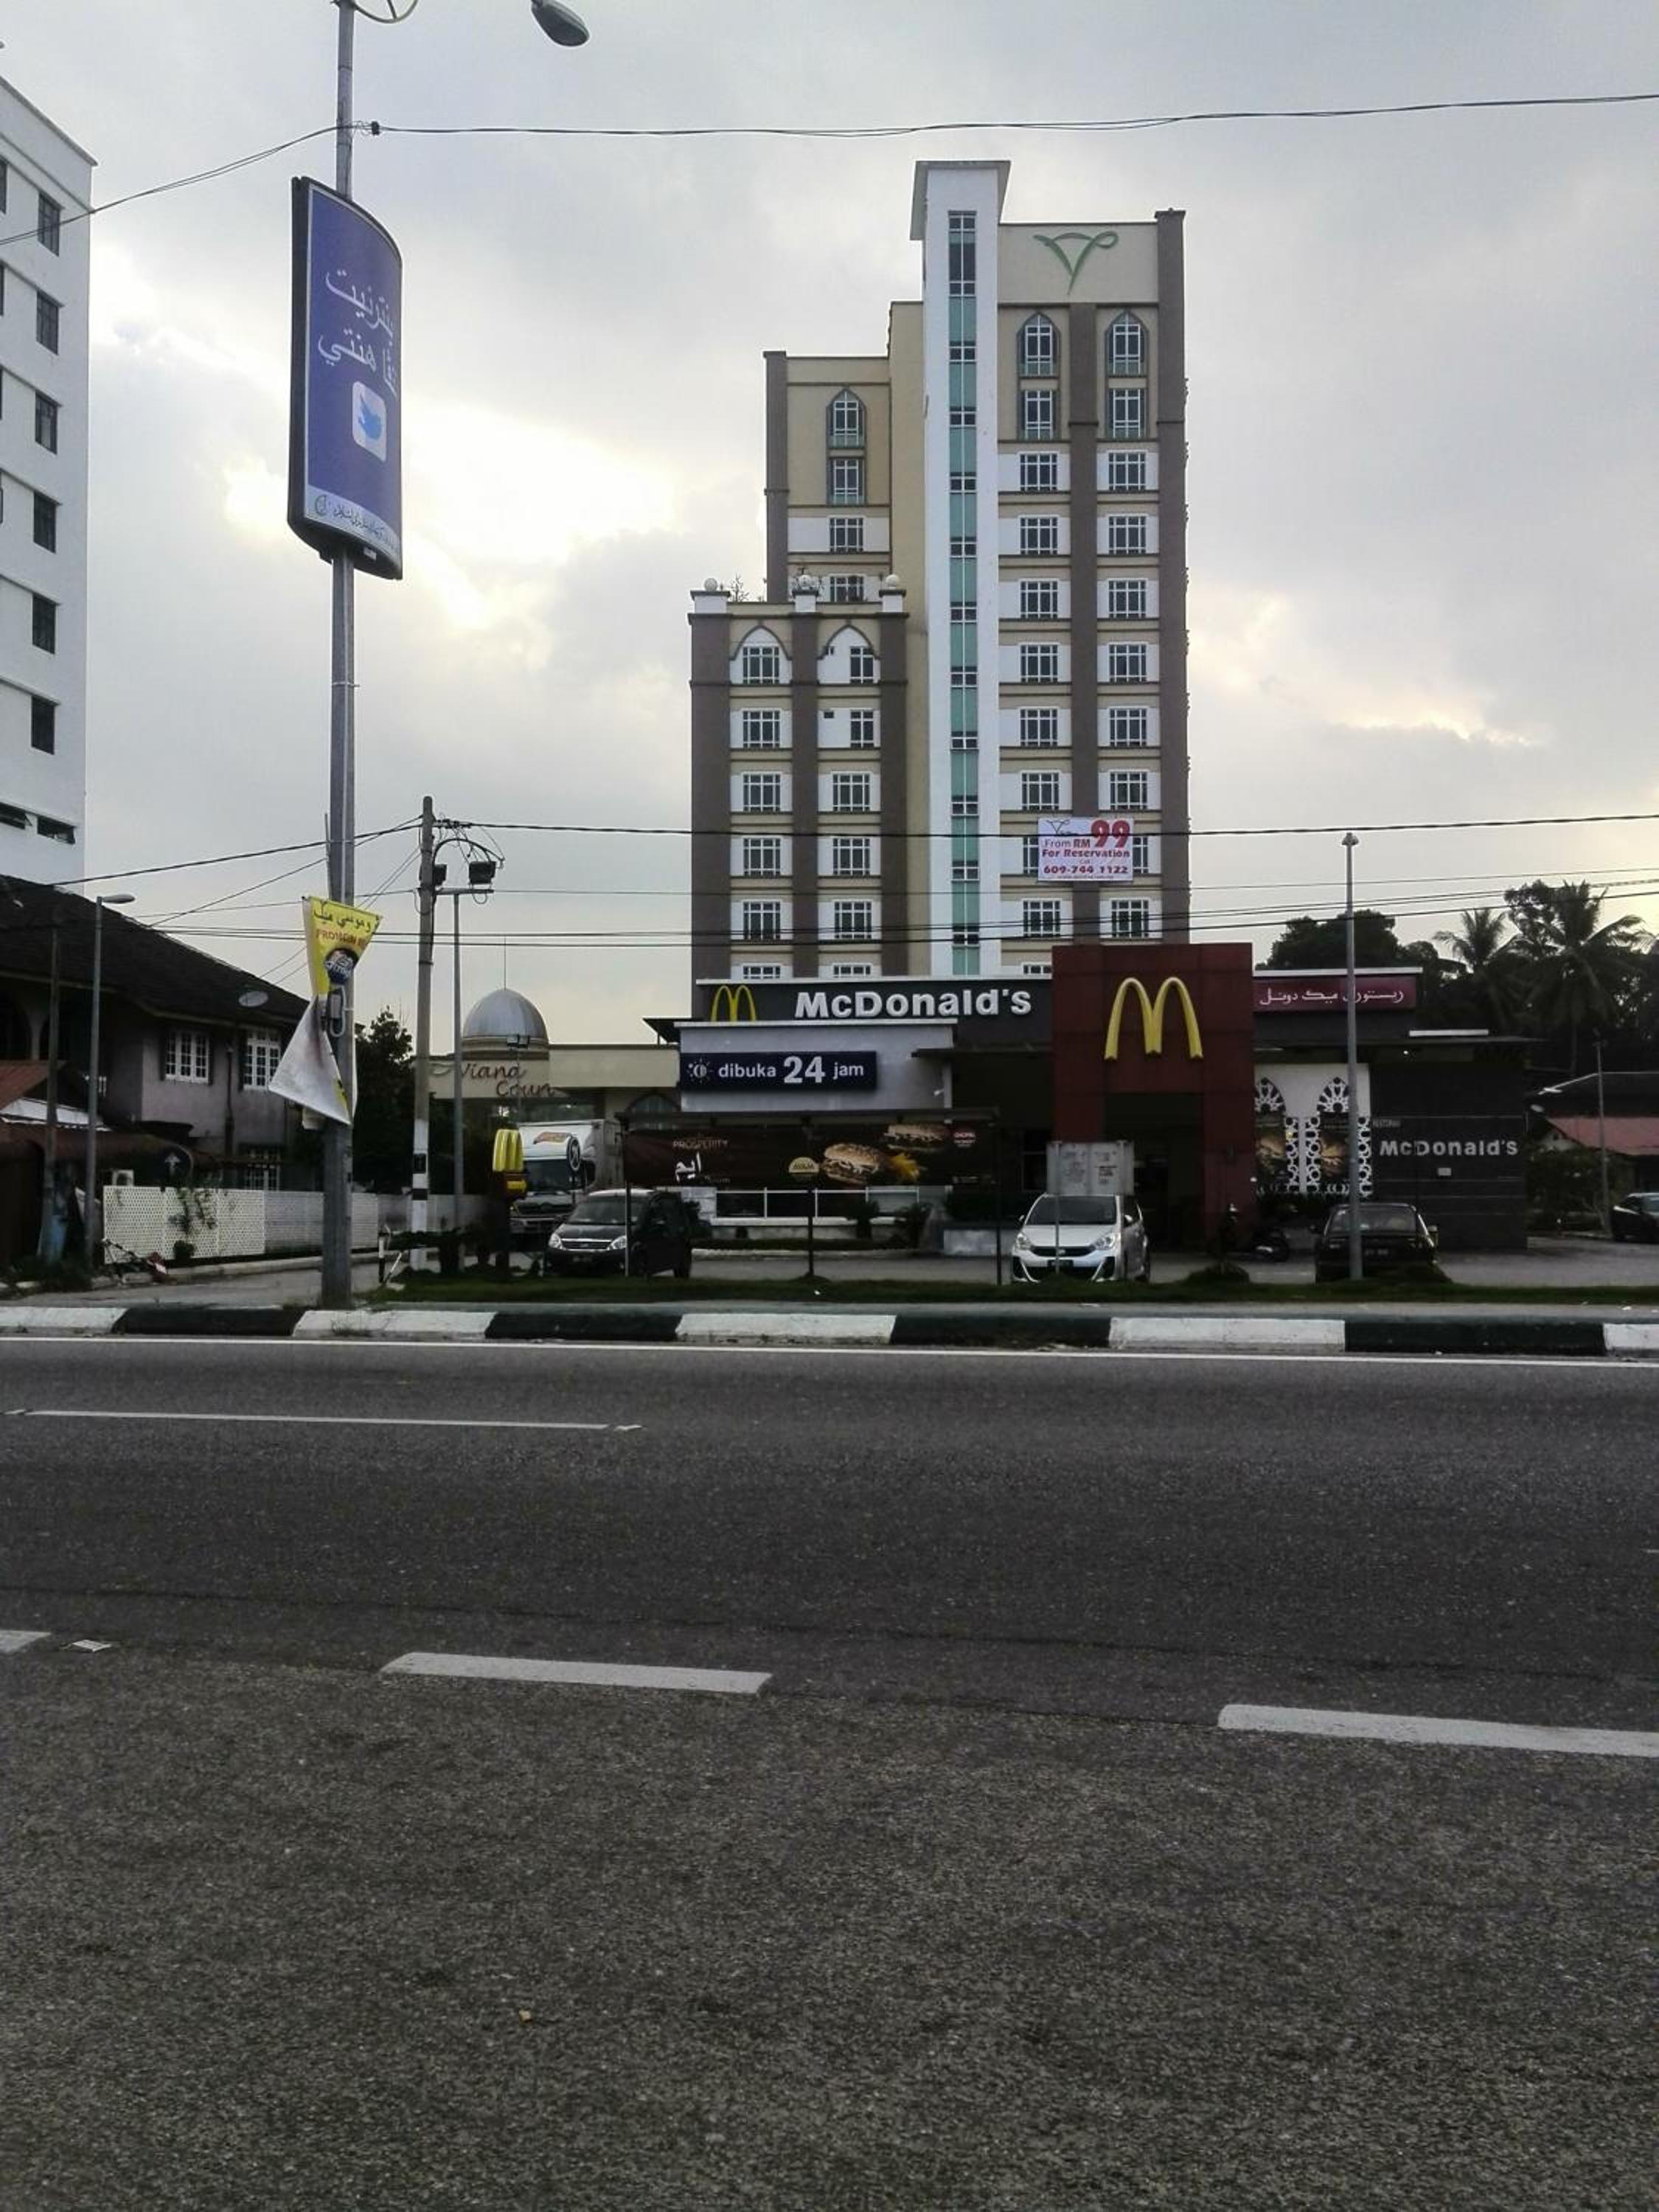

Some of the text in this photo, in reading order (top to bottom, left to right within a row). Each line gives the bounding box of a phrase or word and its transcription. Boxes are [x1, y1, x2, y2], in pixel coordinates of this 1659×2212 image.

[1044, 819, 1130, 848] From RM 99
[1064, 849, 1130, 858] Reservation
[1099, 866, 1129, 874] 1122
[794, 989, 1032, 1018] McDonald's
[718, 1055, 864, 1084] dibuka 24 jam
[1379, 1138, 1519, 1157] McDonald's
